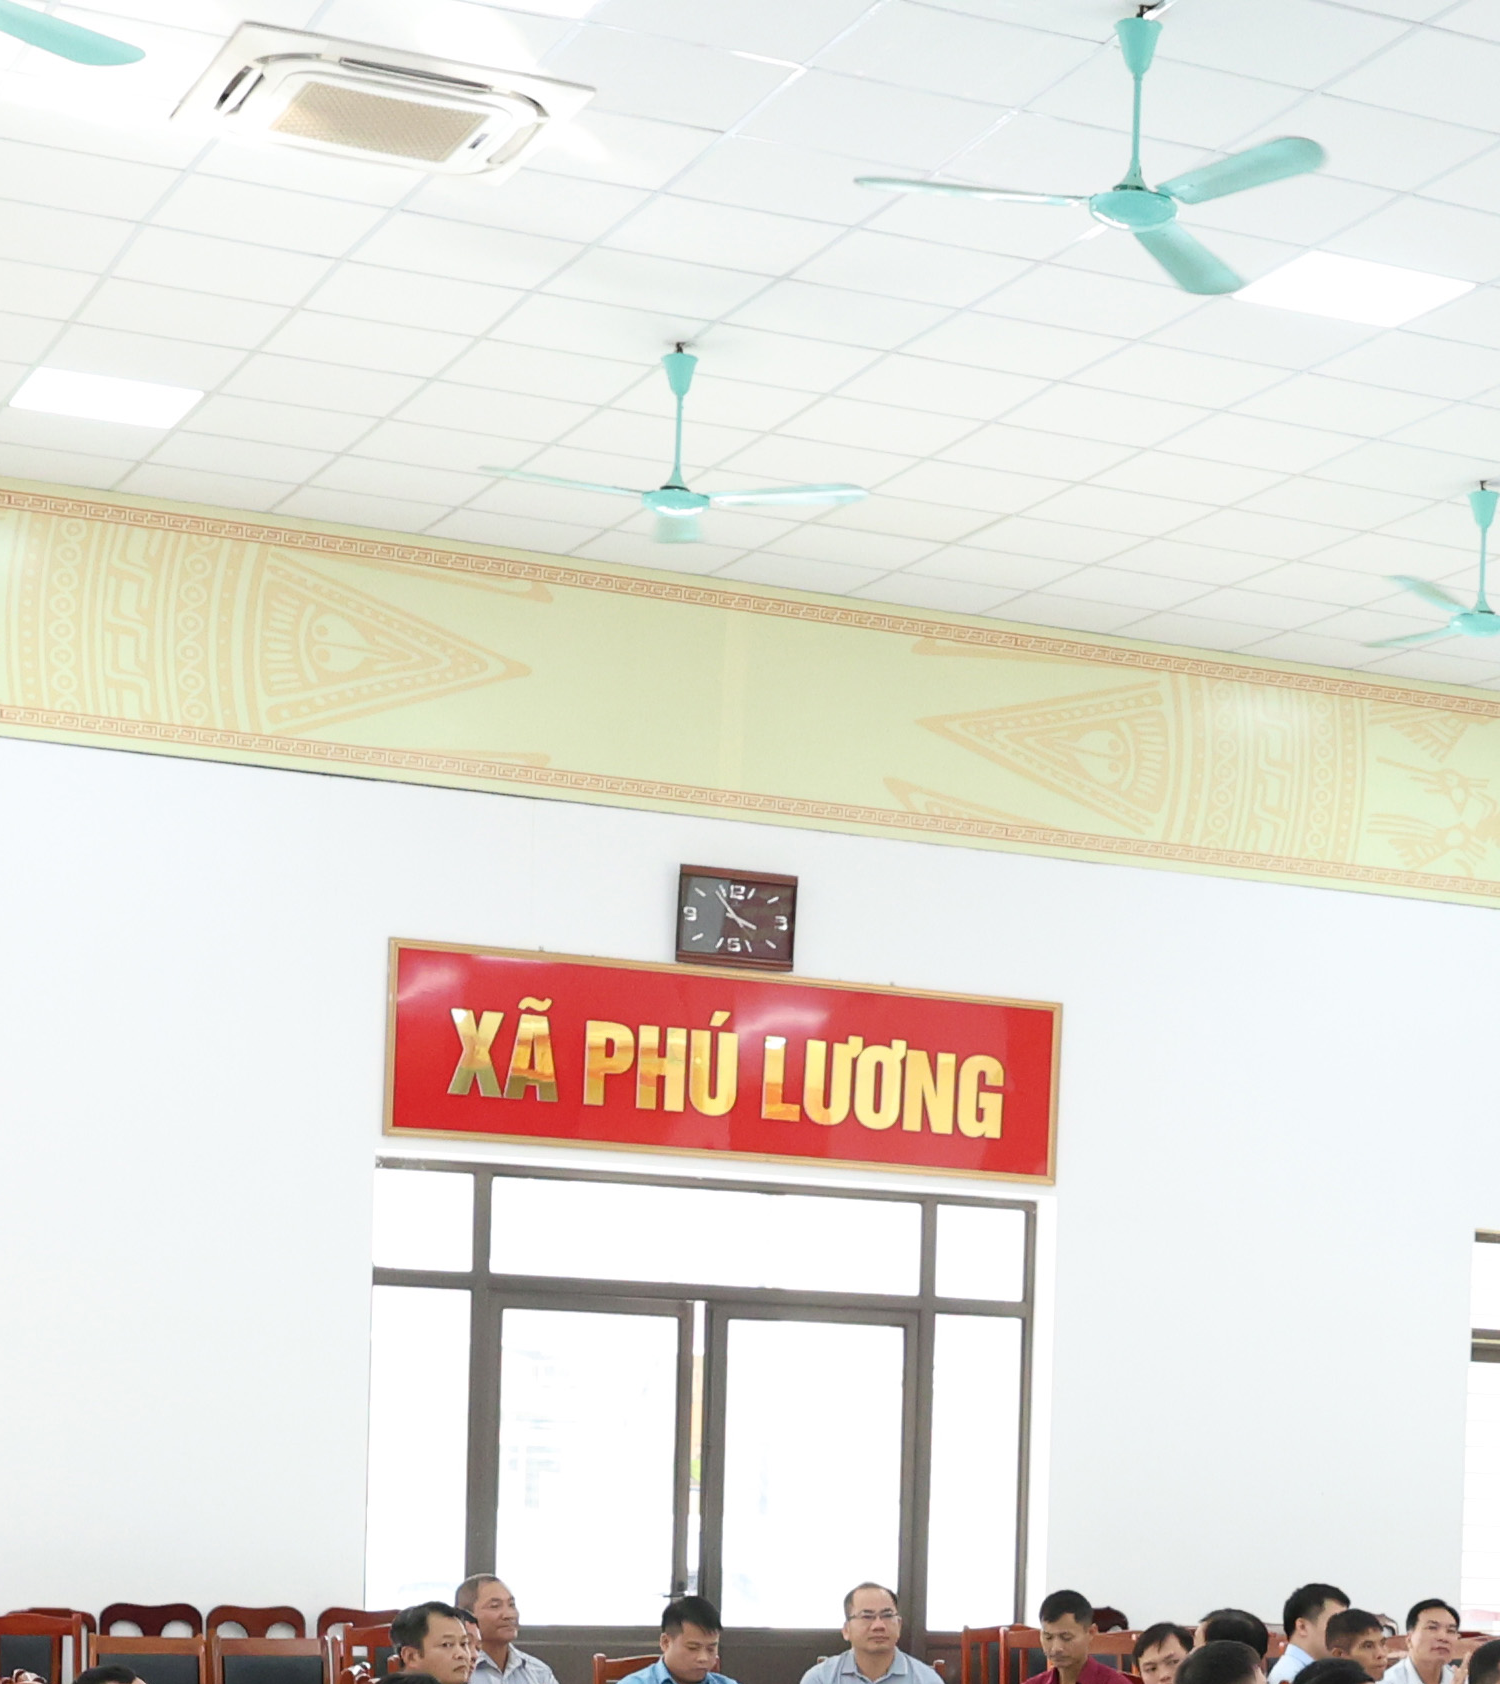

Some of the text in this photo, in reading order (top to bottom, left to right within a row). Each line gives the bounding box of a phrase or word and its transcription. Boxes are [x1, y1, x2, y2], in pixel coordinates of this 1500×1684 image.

[683, 906, 788, 931] 9 3
[447, 997, 1004, 1140] XÃ PHÚ LƯƠNG
